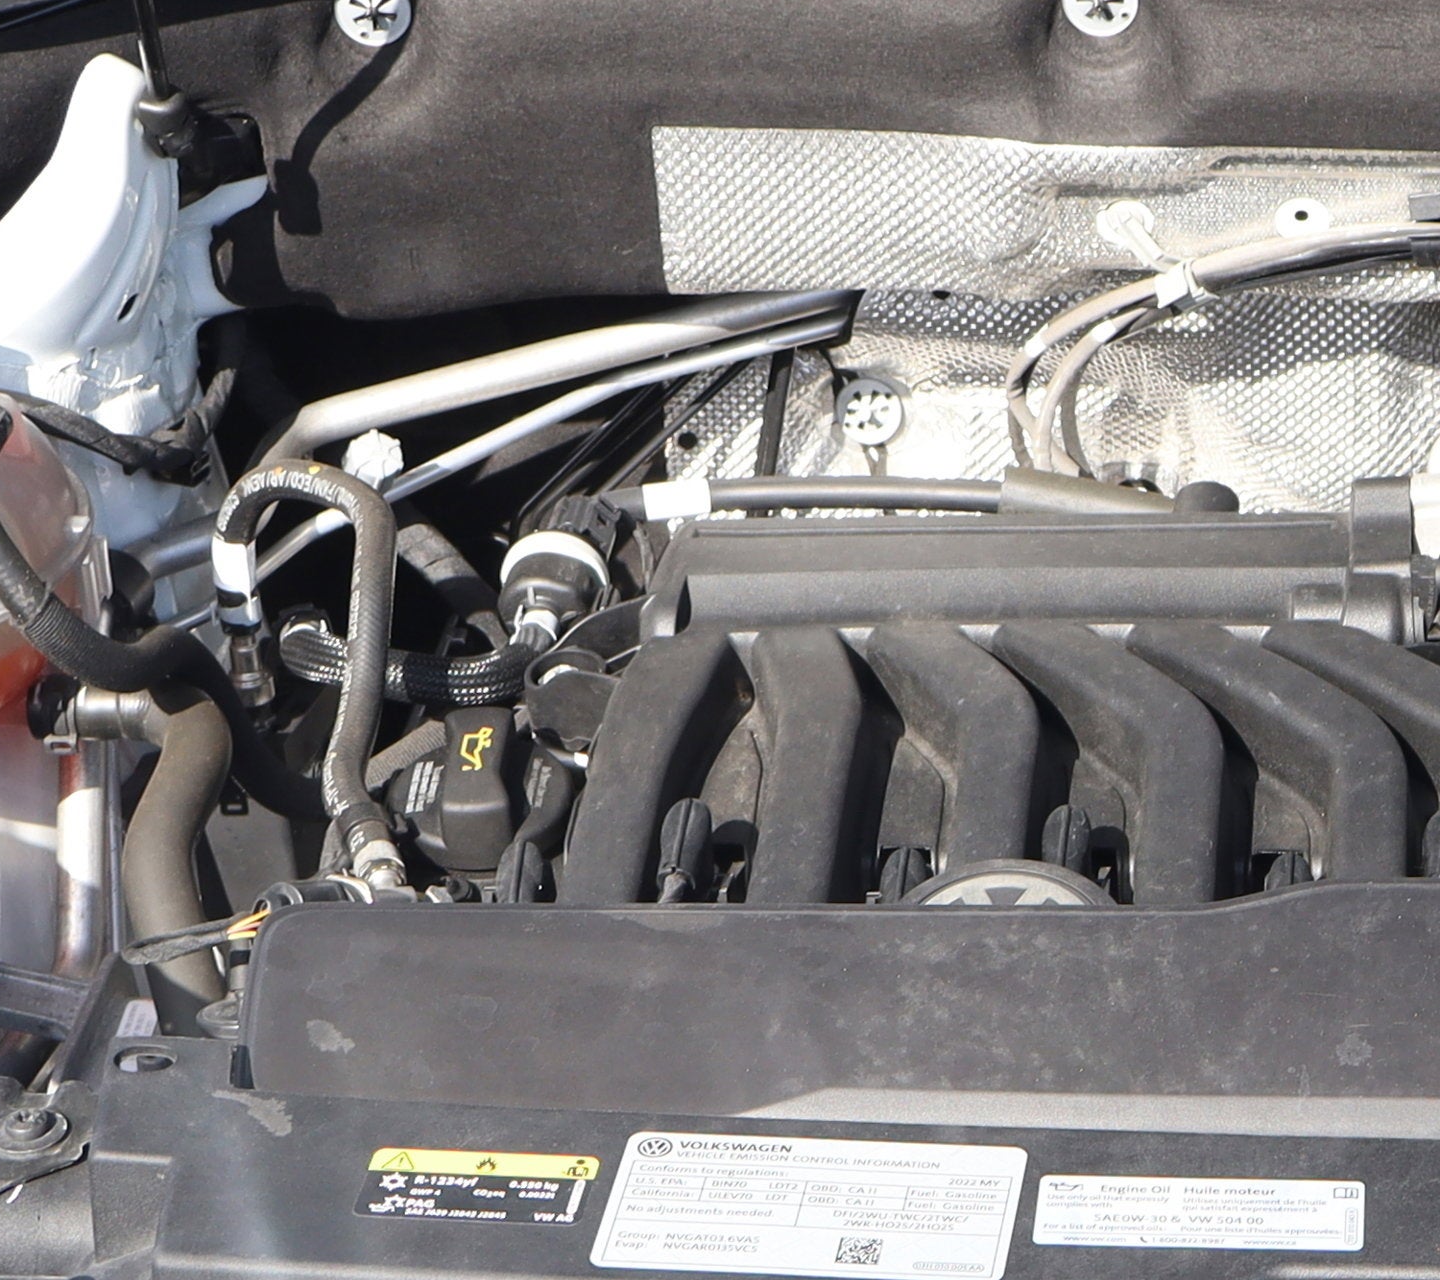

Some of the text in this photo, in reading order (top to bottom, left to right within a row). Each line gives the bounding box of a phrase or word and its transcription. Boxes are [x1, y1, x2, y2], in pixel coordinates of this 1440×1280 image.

[680, 1140, 793, 1153] VOLKSWAGEN
[677, 1150, 941, 1169] VEHICLE EMISSION CONTROL INFORMATION
[639, 1163, 790, 1178] Conforms to regulations:
[635, 1177, 658, 1186] U.S.
[712, 1180, 748, 1188] BIN70
[769, 1182, 799, 1191] LDT2
[948, 1178, 1001, 1187] 2022 MY
[631, 1188, 695, 1198] California:
[811, 1184, 843, 1193] OBD:
[848, 1186, 865, 1194] CA
[1101, 1184, 1276, 1196] Engine Oil Huile moteur
[707, 1191, 753, 1201] ULEV70
[910, 1190, 997, 1200] Fuel: Gasoline
[1125, 1196, 1169, 1204] expressly
[406, 1198, 435, 1209] PAG
[807, 1196, 839, 1205] OBD:
[845, 1197, 863, 1206] CA
[908, 1200, 995, 1212] Fuel: Gasoline
[1046, 1201, 1089, 1209] complies
[1220, 1198, 1281, 1206] uniquement
[626, 1203, 775, 1217] No adjustments needed.
[533, 1212, 554, 1222] VW
[555, 1213, 575, 1223] AG
[1171, 1215, 1181, 1224] &
[1188, 1215, 1212, 1224] VW
[1216, 1216, 1243, 1225] 504
[1245, 1216, 1265, 1225] 00
[617, 1230, 661, 1241] Group:
[614, 1239, 648, 1249] Evap:
